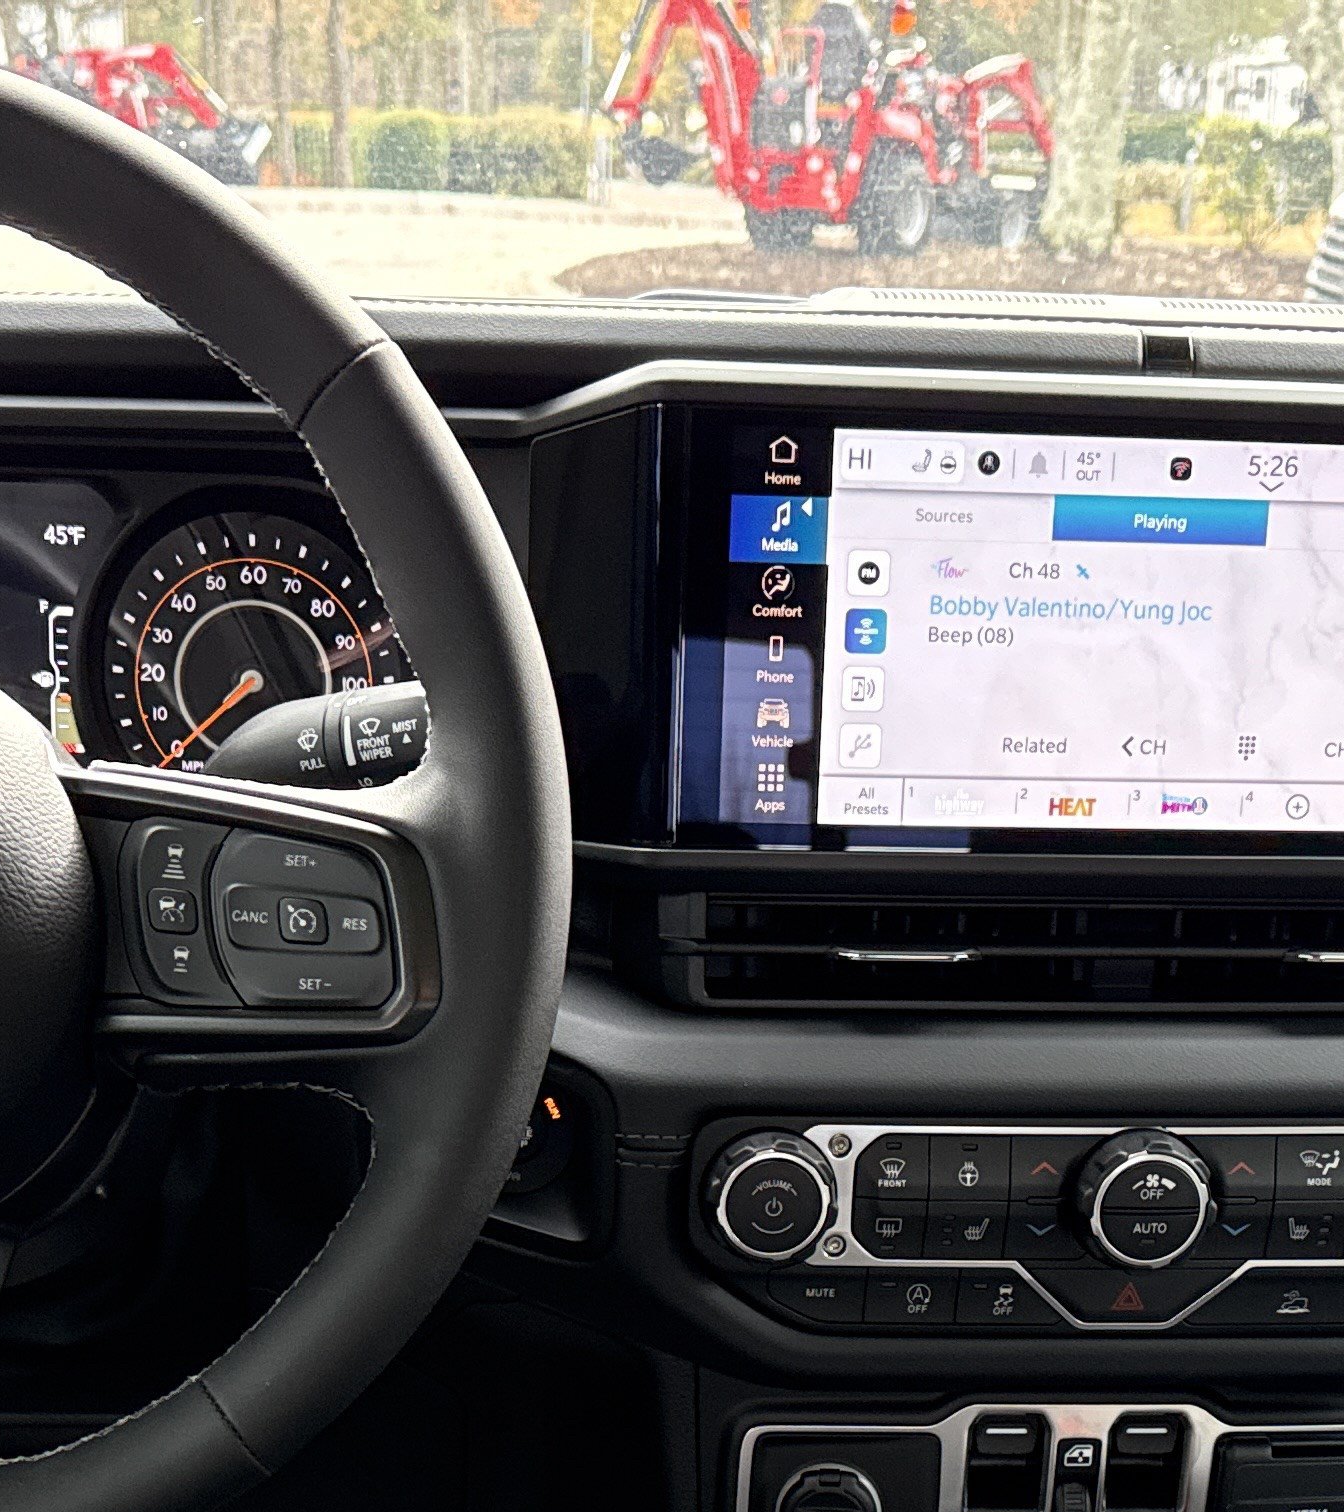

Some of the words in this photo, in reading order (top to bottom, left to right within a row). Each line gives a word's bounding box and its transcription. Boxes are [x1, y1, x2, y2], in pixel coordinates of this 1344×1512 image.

[848, 449, 872, 469] HI
[1247, 455, 1299, 478] 5:26
[764, 471, 801, 486] Home
[1076, 469, 1100, 481] OUT
[916, 508, 973, 524] Sources
[1134, 514, 1187, 533] Playing
[43, 525, 85, 545] 45°F
[761, 538, 798, 553] Media
[240, 565, 267, 585] 60
[861, 567, 877, 579] FM
[1009, 562, 1035, 579] Ch
[1037, 562, 1060, 579] 48
[206, 575, 227, 592] 50
[281, 579, 302, 594] 70
[39, 602, 48, 615] F
[170, 595, 197, 613] 40
[311, 599, 335, 617] 80
[752, 603, 802, 619] Comfort
[929, 595, 997, 620] Bobby
[1004, 597, 1173, 624] Valentino/Yung
[1179, 601, 1212, 622] Joc
[153, 628, 173, 644] 30
[335, 634, 355, 651] 90
[928, 627, 973, 647] Beep
[977, 627, 1014, 647] (08)
[140, 664, 165, 683] 20
[756, 669, 794, 684] Phone
[342, 677, 367, 692] 100
[153, 706, 167, 721] 10
[392, 719, 418, 733] MIST
[357, 734, 390, 749] FRONT
[751, 734, 794, 748] Vehicle
[1002, 738, 1067, 755] Related
[1140, 739, 1166, 755] CH
[359, 746, 393, 762] WIPER
[300, 757, 326, 771] PULL
[859, 788, 875, 800] All
[908, 787, 914, 797] 1
[1021, 788, 1028, 799] 2
[1133, 790, 1140, 801] 3
[1245, 793, 1254, 803] 4
[755, 798, 785, 814] Apps
[844, 801, 889, 817] Presets
[1049, 797, 1096, 817] HEAT
[232, 909, 268, 924] CANC
[343, 917, 367, 931] RES
[756, 1179, 795, 1192] VOLUME
[878, 1179, 907, 1188] FRONT
[1307, 1178, 1332, 1187] MODE
[1140, 1188, 1164, 1200] OFF
[1133, 1222, 1167, 1235] AUTO
[806, 1287, 835, 1298] MUTE
[907, 1303, 927, 1314] OFF
[993, 1304, 1013, 1316] OFF
